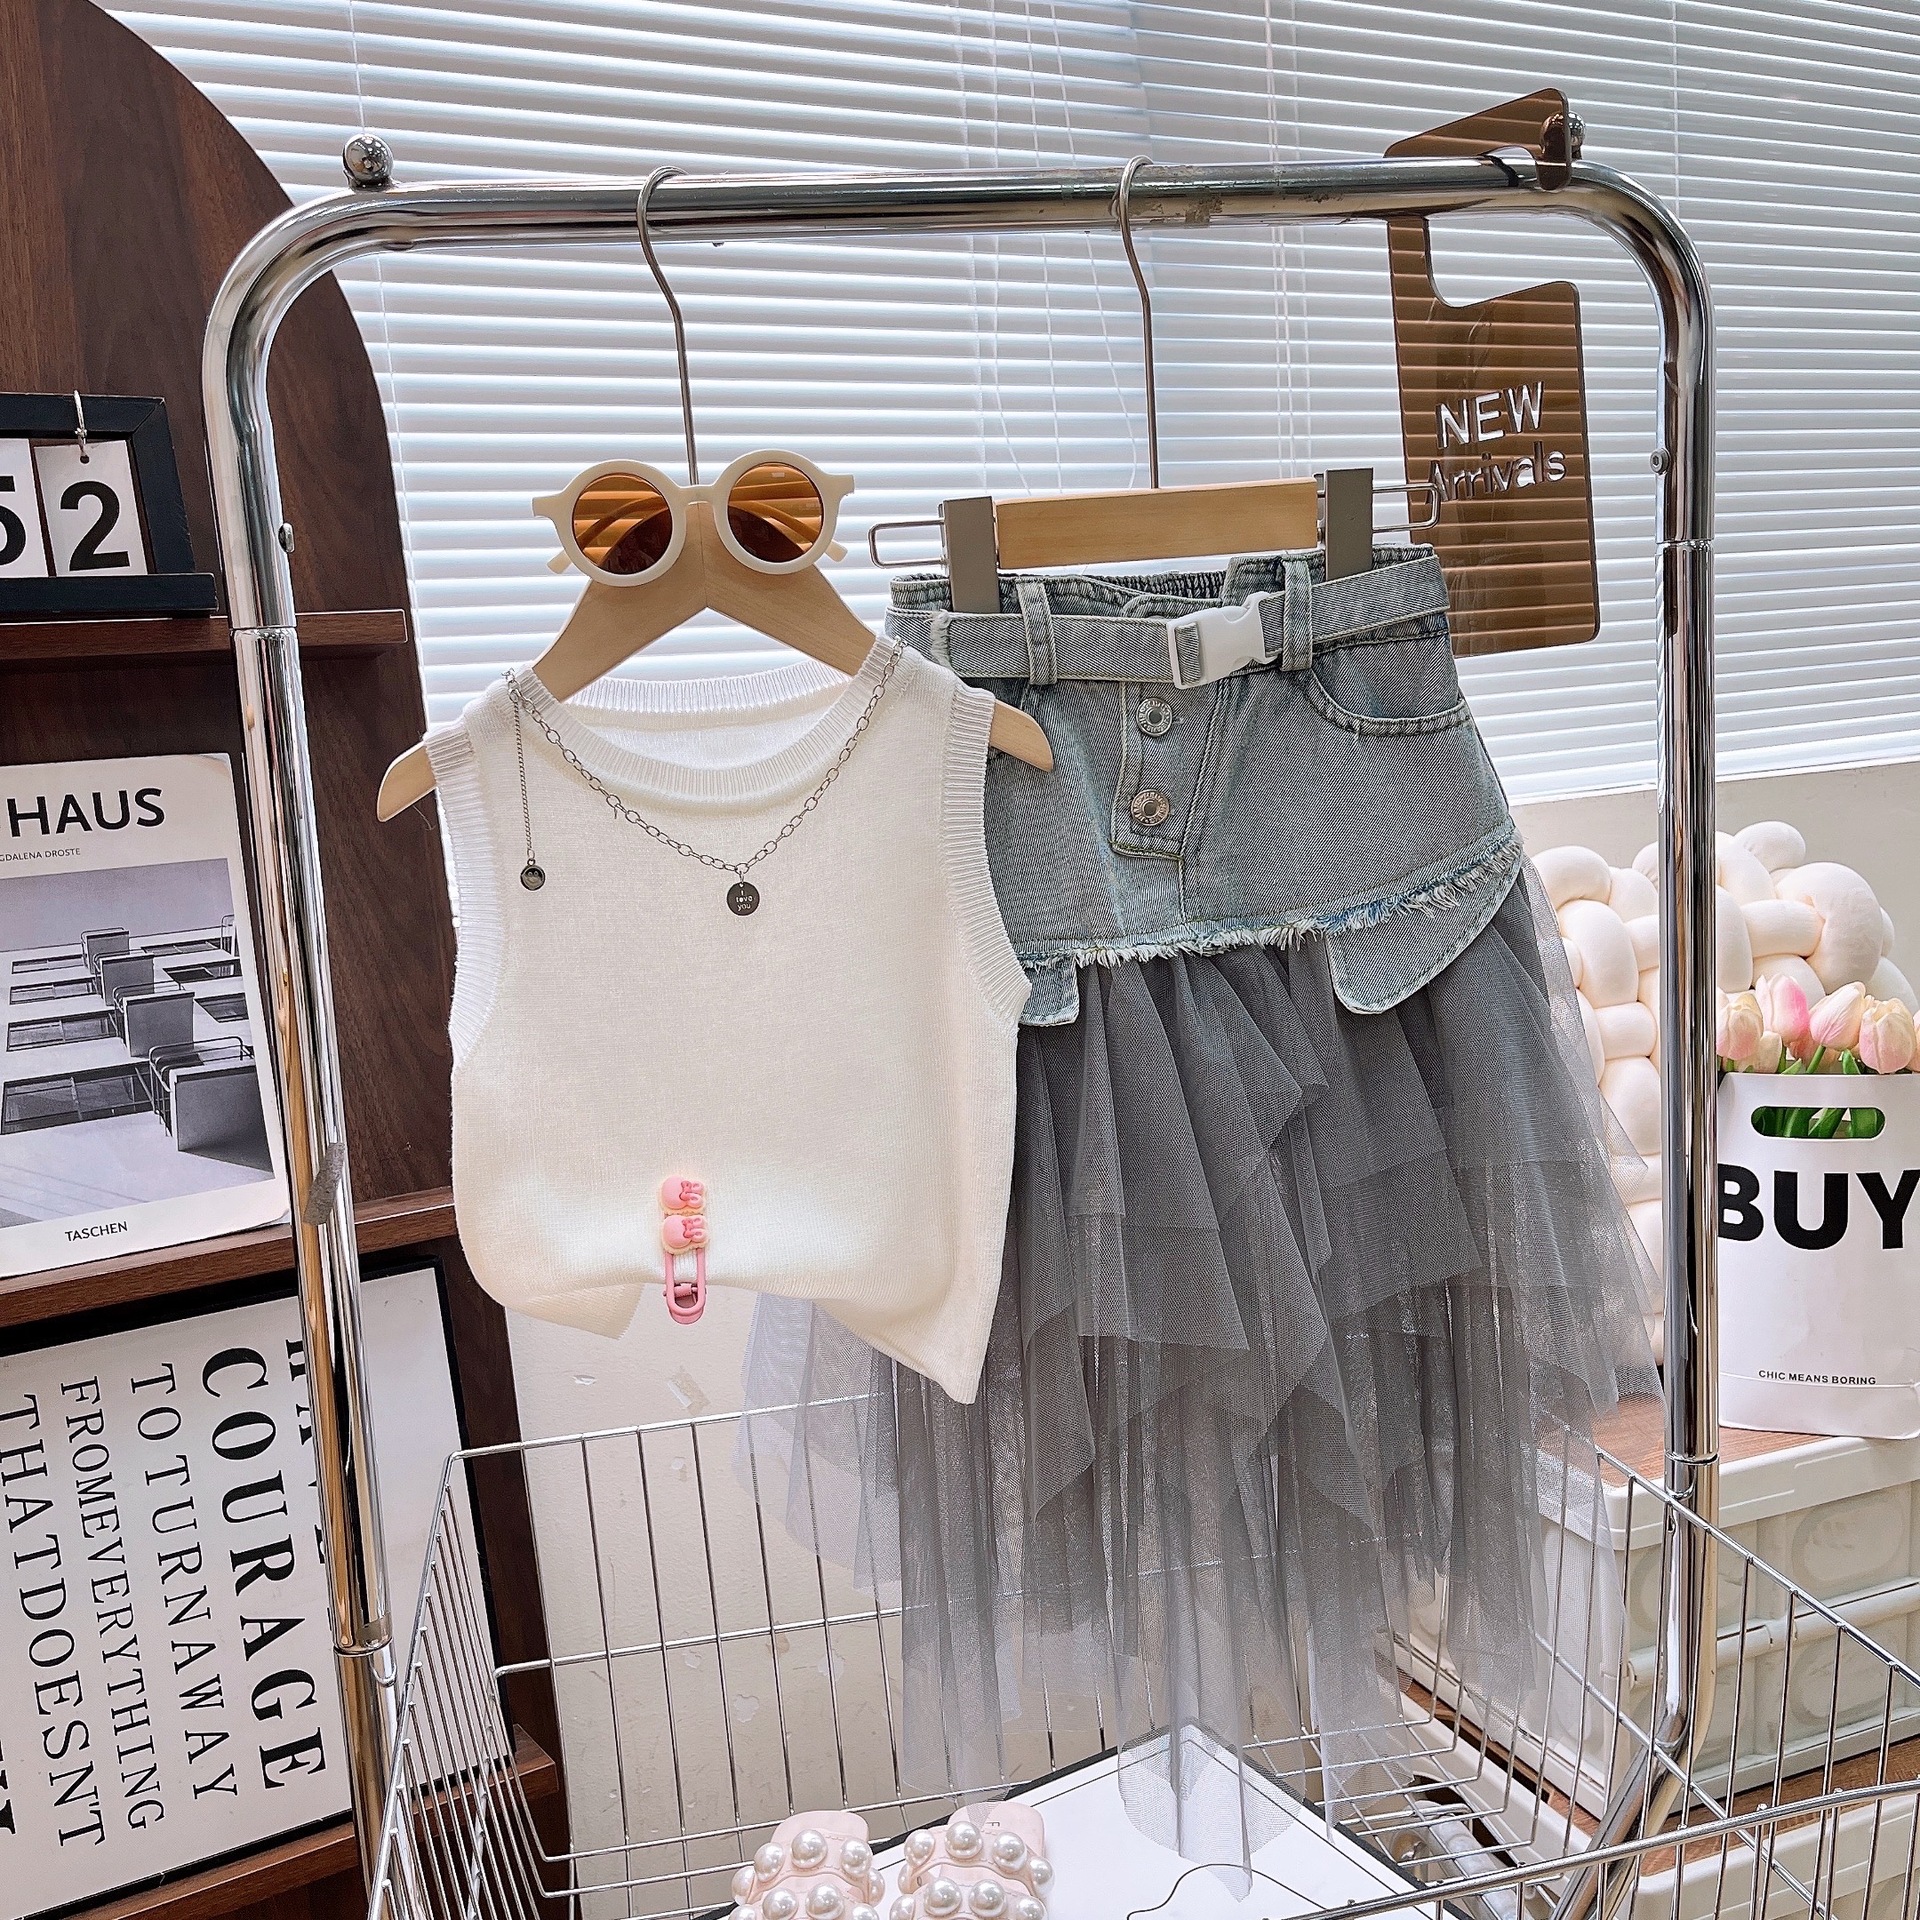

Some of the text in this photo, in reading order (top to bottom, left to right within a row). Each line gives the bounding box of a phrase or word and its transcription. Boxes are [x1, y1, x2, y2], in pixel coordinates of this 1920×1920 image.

[1436, 381, 1544, 449] NEW
[1426, 441, 1566, 504] Arrivals
[7, 788, 165, 837] HAUS
[45, 847, 81, 858] DROSTE
[65, 1221, 128, 1242] TASCHEN
[1717, 1163, 1920, 1250] BUY
[1758, 1370, 1876, 1386] CHIC MEANS BORING
[202, 1347, 327, 1790] COURAGE
